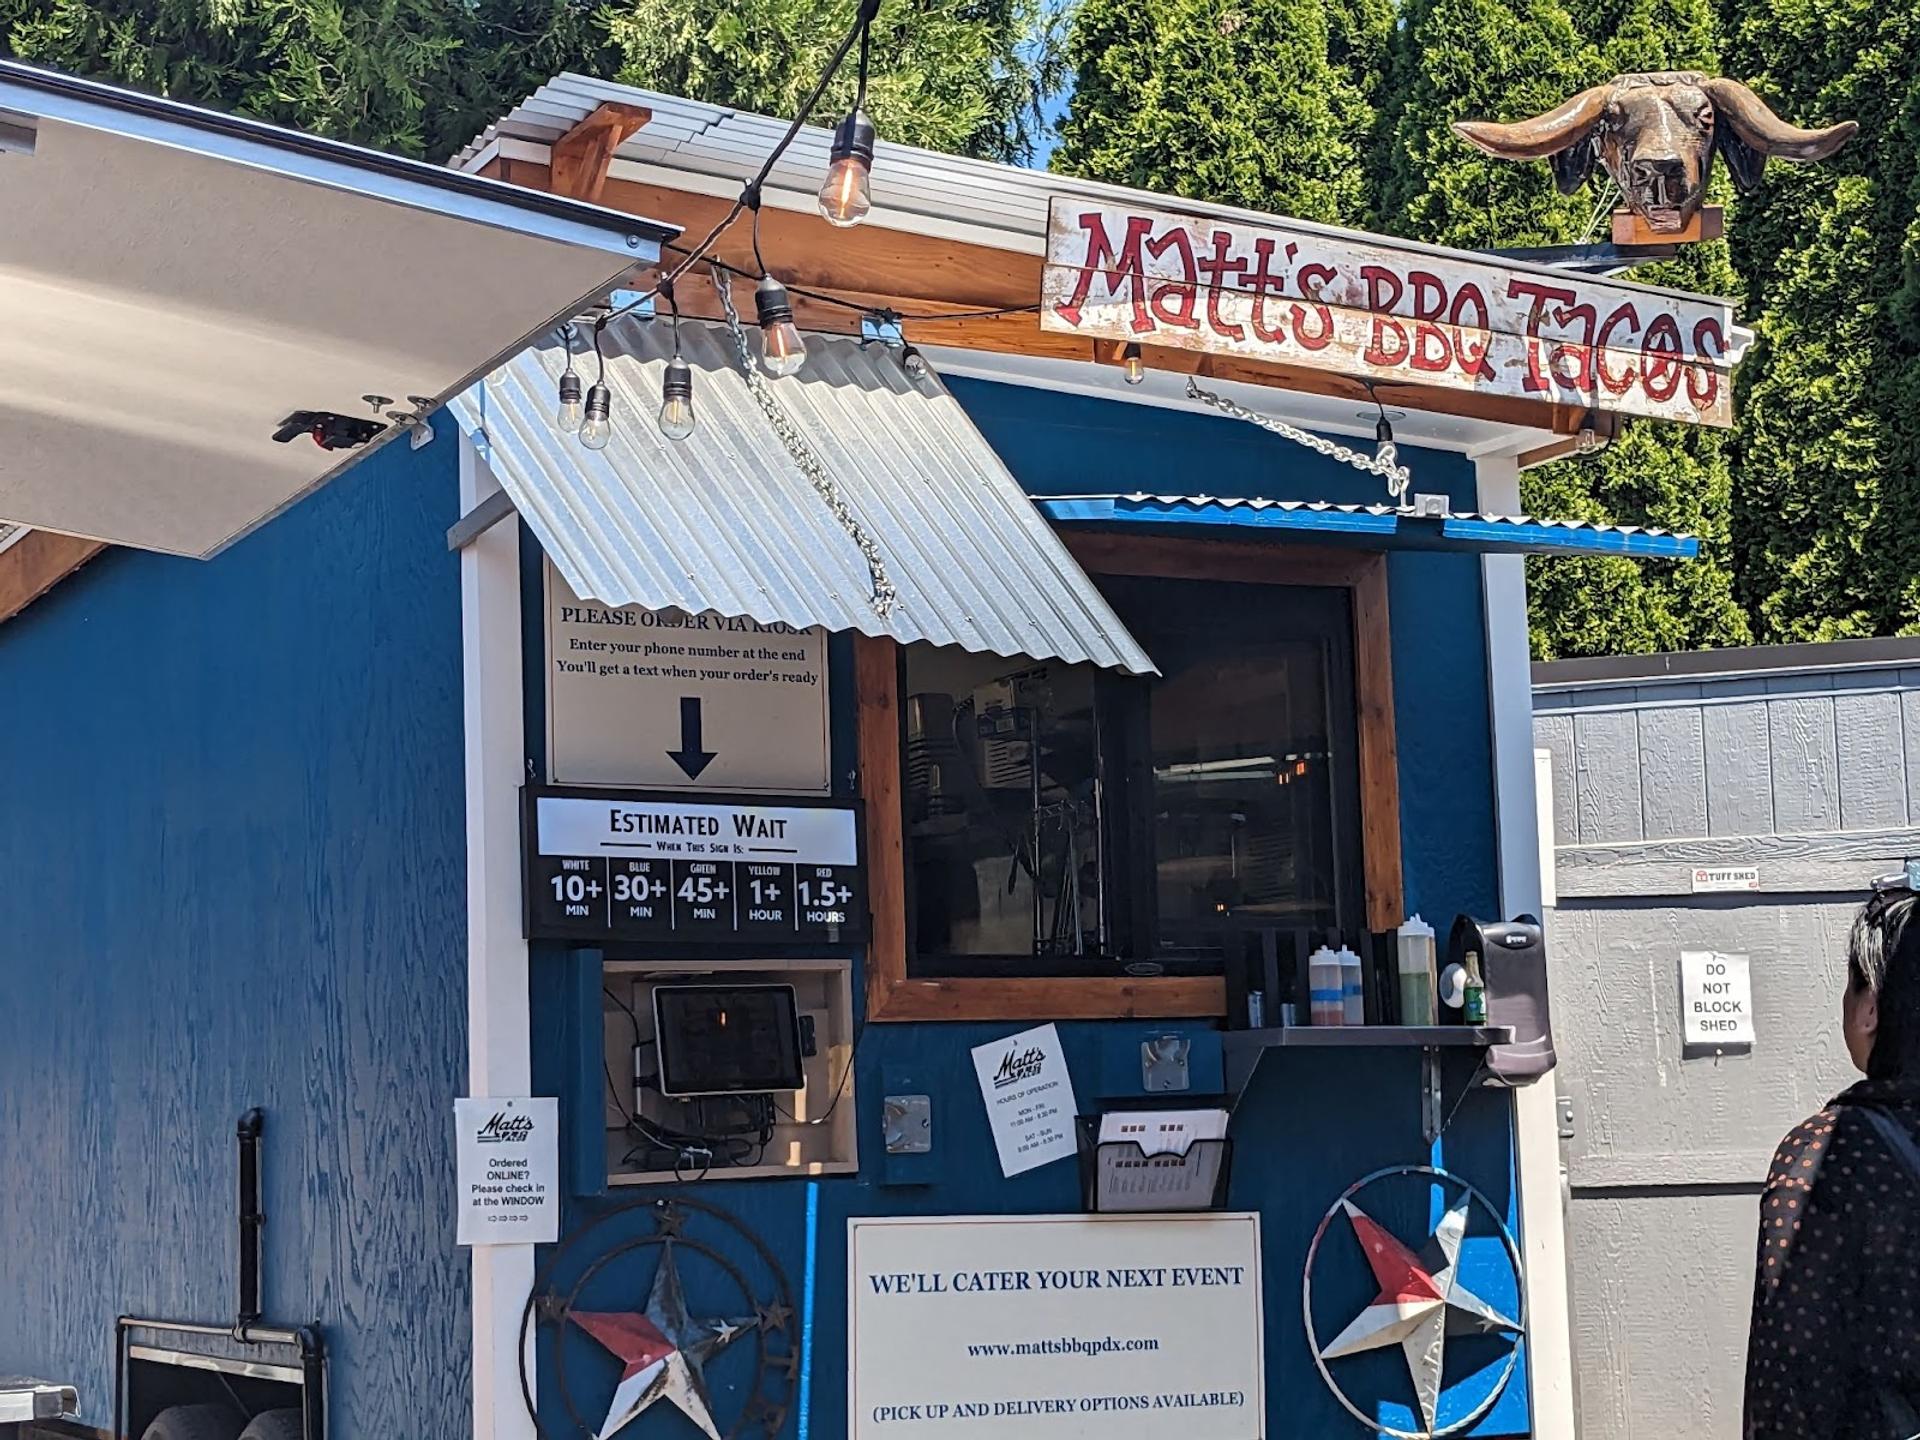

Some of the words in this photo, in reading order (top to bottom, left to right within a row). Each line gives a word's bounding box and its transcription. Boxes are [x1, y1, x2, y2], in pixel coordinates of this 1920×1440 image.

[1053, 212, 1338, 351] Matt's
[1360, 265, 1497, 383] BBQ
[561, 606, 636, 626] PLEASE
[713, 616, 748, 632] VIA
[569, 638, 607, 651] Enter
[610, 643, 641, 655] your
[644, 642, 685, 656] phone
[688, 645, 740, 659] number
[743, 648, 754, 660] at
[758, 647, 779, 660] the
[781, 650, 805, 661] end
[556, 660, 596, 673] You'll
[599, 664, 619, 676] get
[623, 666, 630, 675] a
[633, 665, 659, 676] text
[661, 665, 697, 678] when
[700, 670, 731, 681] your
[733, 669, 779, 682] order's
[781, 671, 819, 686] ready
[562, 860, 590, 871] WHITE
[629, 861, 650, 872] BLUE
[690, 863, 717, 874] GREEN
[748, 865, 781, 876] YELLOW
[816, 868, 833, 878] RED
[1708, 871, 1731, 881] TUFF
[1733, 871, 1756, 880] SHED
[551, 874, 603, 901] 10+
[614, 874, 667, 901] 30+
[677, 877, 730, 903] 45+
[750, 879, 781, 905] 1+
[798, 881, 853, 907] 1.5+
[566, 904, 590, 916] MIN
[630, 906, 652, 918] MIN
[693, 908, 716, 919] MIN
[749, 909, 782, 921] HOUR
[806, 911, 845, 923] HOURS
[1706, 963, 1726, 975] DO
[1702, 982, 1731, 994] NOT
[1694, 1001, 1742, 1013] BLOCK
[1700, 1019, 1738, 1031] SHED
[993, 1047, 1046, 1081] Matt's
[477, 1112, 535, 1138] Matt's
[489, 1158, 527, 1167] Ordered
[487, 1171, 529, 1180] ONLINE?
[471, 1184, 502, 1193] Please
[505, 1183, 533, 1193] check
[536, 1183, 544, 1192] in
[472, 1198, 480, 1206] at
[484, 1197, 499, 1206] the
[501, 1196, 544, 1205] WINDOW
[869, 1273, 947, 1294] WE'LL
[953, 1271, 1031, 1292] CATER
[1036, 1270, 1102, 1290] YOUR
[1106, 1269, 1167, 1288] NEXT
[1172, 1267, 1244, 1286] EVENT
[967, 1336, 1160, 1357] www.mattsbbqpdx.com
[873, 1405, 921, 1423] (PICK
[926, 1404, 949, 1419] UP
[953, 1402, 989, 1418] AND
[994, 1398, 1077, 1416] DELIVERY
[1080, 1395, 1150, 1412] OPTIONS
[1153, 1390, 1245, 1410] AVAILABLE)
